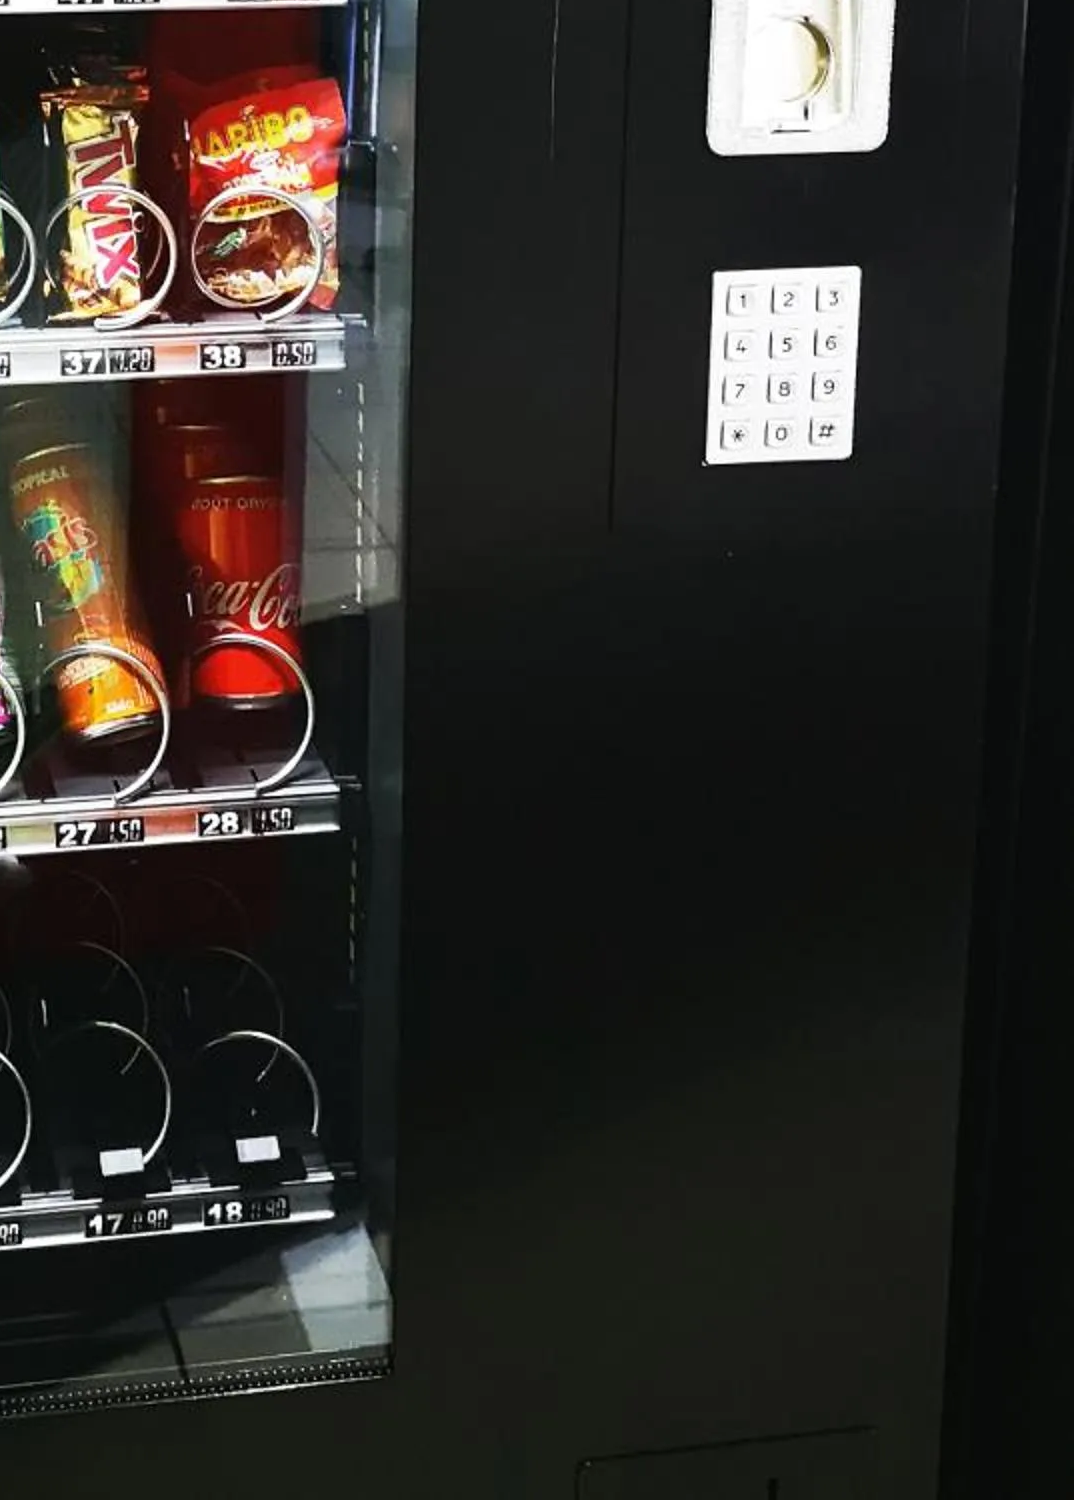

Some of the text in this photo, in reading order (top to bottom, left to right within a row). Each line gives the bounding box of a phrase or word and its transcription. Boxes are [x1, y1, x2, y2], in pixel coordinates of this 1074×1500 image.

[75, 115, 139, 287] TWIX
[782, 291, 796, 308] 2
[828, 289, 840, 307] 3
[203, 341, 314, 368] 38 0.50
[735, 334, 838, 354] 4 5 6
[64, 348, 151, 375] 37 1.20
[734, 379, 836, 399] 7 8 9
[775, 426, 789, 441] 0
[58, 818, 142, 846] 27 1.50
[202, 812, 241, 835] 28
[88, 1208, 169, 1238] 17 0.90
[206, 1201, 244, 1224] 18
